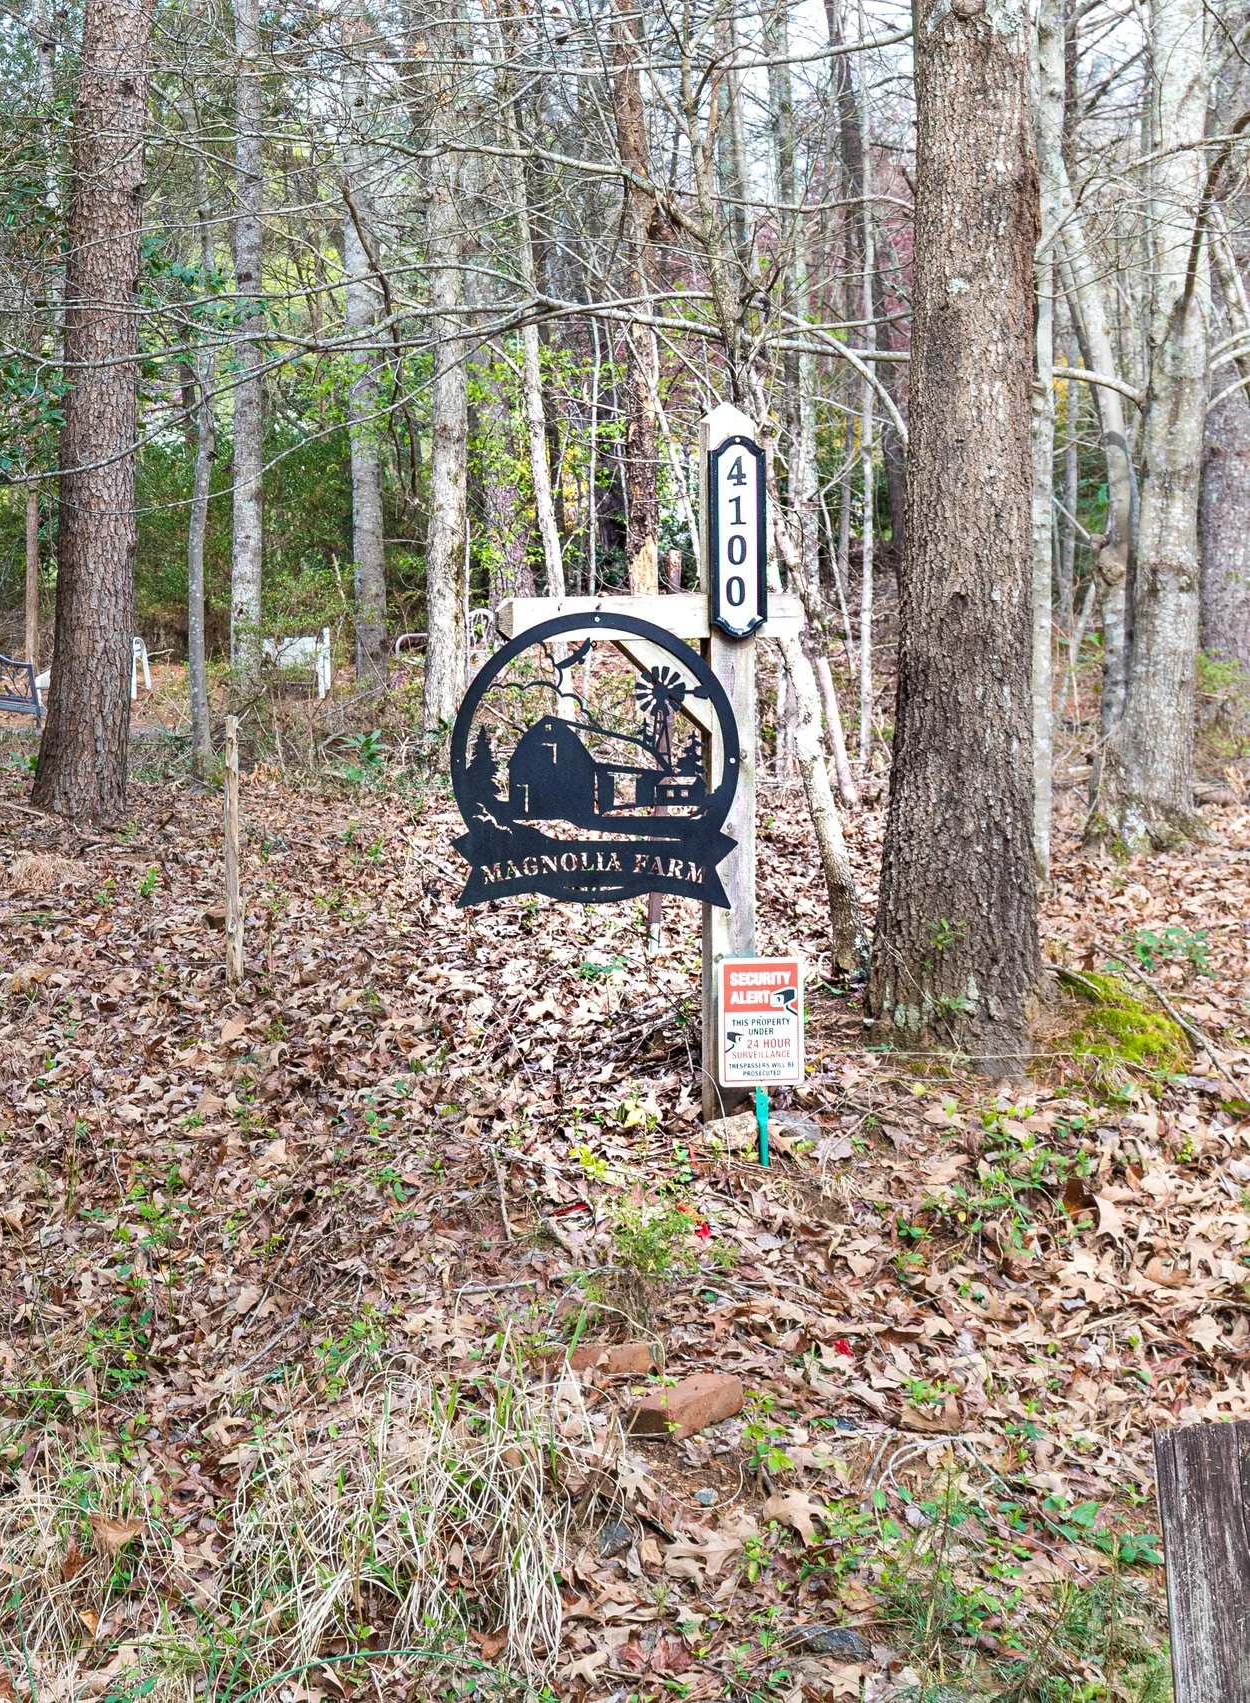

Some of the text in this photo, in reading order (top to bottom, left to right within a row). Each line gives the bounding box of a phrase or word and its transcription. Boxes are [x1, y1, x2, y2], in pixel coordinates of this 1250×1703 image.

[726, 455, 747, 606] 4100
[480, 852, 707, 885] MAGNOLIA FARM
[729, 971, 791, 986] SECURITY
[730, 990, 771, 1005] ALERT
[732, 1017, 791, 1027] THIS PROPERTY
[748, 1027, 774, 1035] UNDER
[747, 1038, 791, 1049] 24 HOUR
[731, 1050, 791, 1059] SURVEILLANCE
